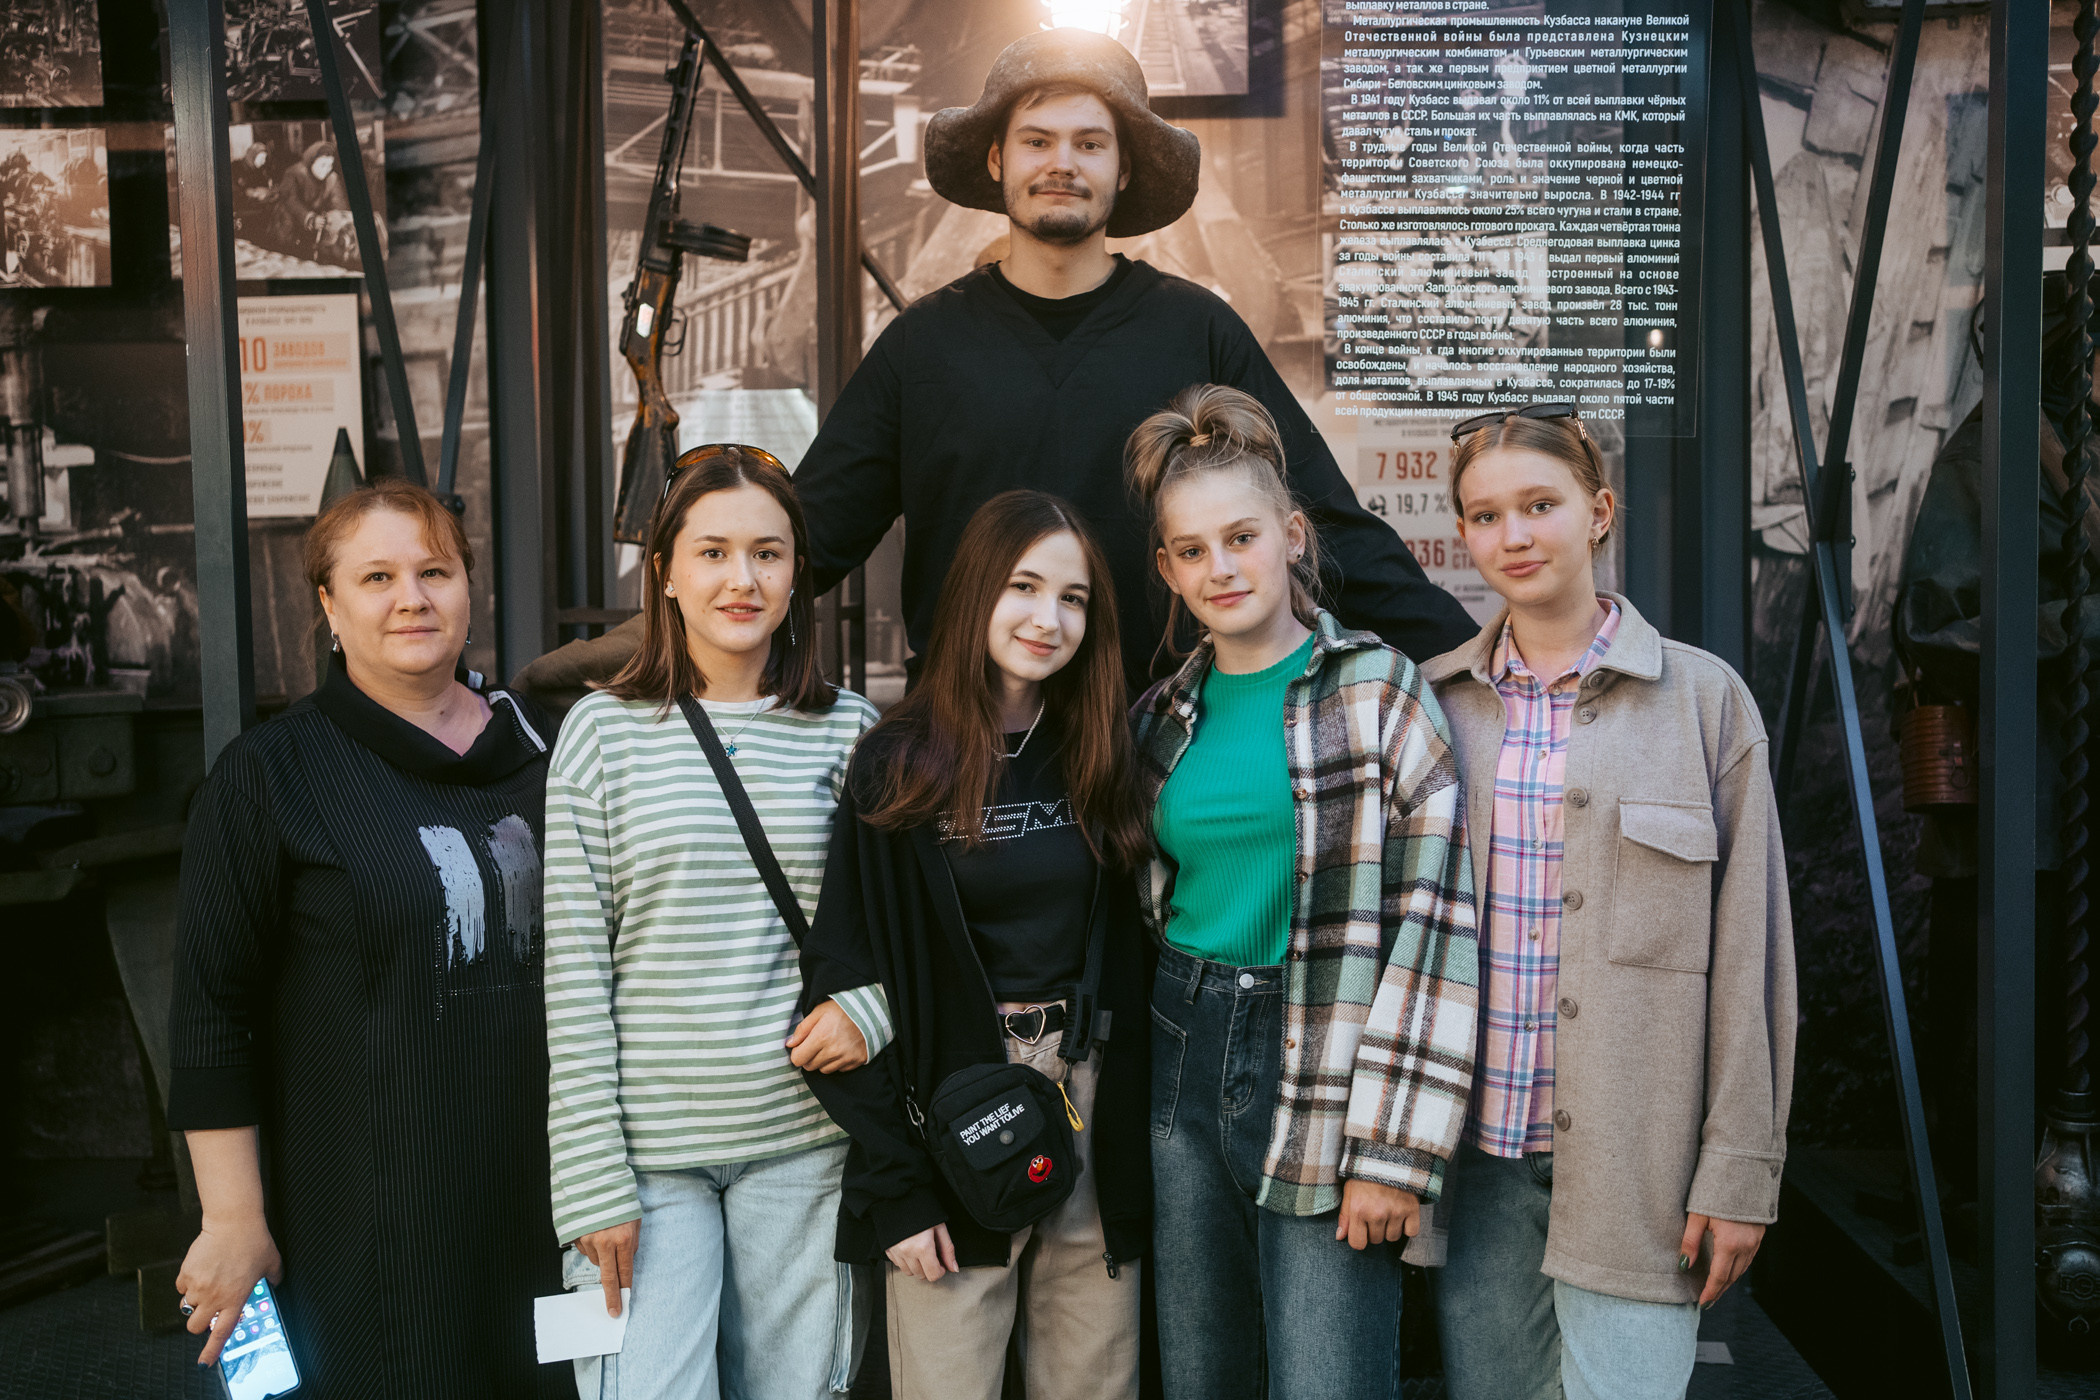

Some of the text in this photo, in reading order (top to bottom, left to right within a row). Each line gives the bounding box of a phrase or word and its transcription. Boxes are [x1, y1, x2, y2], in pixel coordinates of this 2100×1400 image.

[1345, 1, 1490, 12] выплавку металлов стране.
[1353, 15, 1447, 28] Металлургическая
[1450, 17, 1541, 28] промышленность
[1594, 17, 1643, 28] накануне
[1646, 15, 1690, 25] Великой
[1345, 31, 1689, 44] Отечественной войны была представлена Кузнецким
[1344, 47, 1688, 60] металлургическим комбинатом Гурьевским металлургическим
[1344, 63, 1688, 76] заводом, первым цветной металлургии
[1343, 78, 1496, 91] Сибири Беловским цинковым
[1360, 94, 1381, 105] 1941
[1383, 97, 1406, 107] году
[1409, 94, 1450, 107] Кузбасс
[1500, 97, 1531, 105] около
[1533, 94, 1550, 105] 11%
[1567, 94, 1591, 105] всей
[1594, 97, 1645, 105] выплавки
[1648, 95, 1687, 108] чёрных
[1343, 110, 1686, 124] металлов СССР. Большая часть выплавлялась КМК, который
[1342, 128, 1478, 139] давал сталь прокат.
[1411, 142, 1685, 154] годы Великой Отечественной войны, когда часть
[1408, 157, 1469, 168] Советского
[1516, 157, 1544, 168] была
[1550, 160, 1626, 171] оккупирована
[1632, 160, 1684, 170] немецко-
[1341, 173, 1683, 186] фашисткими захватчиками, роль значение черной цветной
[1340, 191, 1409, 202] металлургии
[1470, 191, 1538, 200] значительно
[1544, 192, 1595, 202] выросла.
[1613, 190, 1665, 200] 1942-1944
[1349, 203, 1682, 218] Кузбассе выплавлялось около 25% всего чугуна стали стране.
[1339, 219, 1681, 234] Столько изготовлялось готового проката. Каждая четвёртая тонна
[1464, 236, 1681, 249] Кузбассе. Среднегодовая выплавка цинка
[1354, 252, 1680, 265] годы выдал первый алюминий
[1639, 271, 1680, 279] основе
[1425, 282, 1498, 295] Запорожского
[1614, 284, 1644, 294] Всего
[1653, 284, 1679, 294] 1943-
[1338, 296, 1359, 307] 1945
[1557, 299, 1605, 312] произвёл
[1628, 302, 1649, 310] тыс.
[1655, 302, 1678, 311] тонн
[1337, 315, 1678, 327] алюминия, составило часть всего алюминия,
[1337, 329, 1515, 341] произведенного СССР годы войны.
[1355, 344, 1676, 359] конце войны, гда многие оккупированные территории были
[1336, 359, 1676, 375] освобождены, народного хозяйства,
[1335, 377, 1676, 391] доля металлов, Кузбассе, сократилась 17-19%
[1350, 390, 1423, 402] общесоюзной.
[1437, 391, 1459, 401] 1945
[1462, 393, 1485, 404] году
[1488, 392, 1529, 405] Кузбасс
[1580, 395, 1610, 403] около
[1613, 393, 1642, 404] пятой
[1645, 396, 1674, 404] части
[1359, 408, 1414, 418] продукции
[1598, 409, 1625, 420] СССР.
[1396, 493, 1428, 516] 19,7
[960, 1102, 1010, 1139] PAINT THE LIEF
[963, 1131, 981, 1146] YOU
[979, 1119, 1001, 1137] WANT
